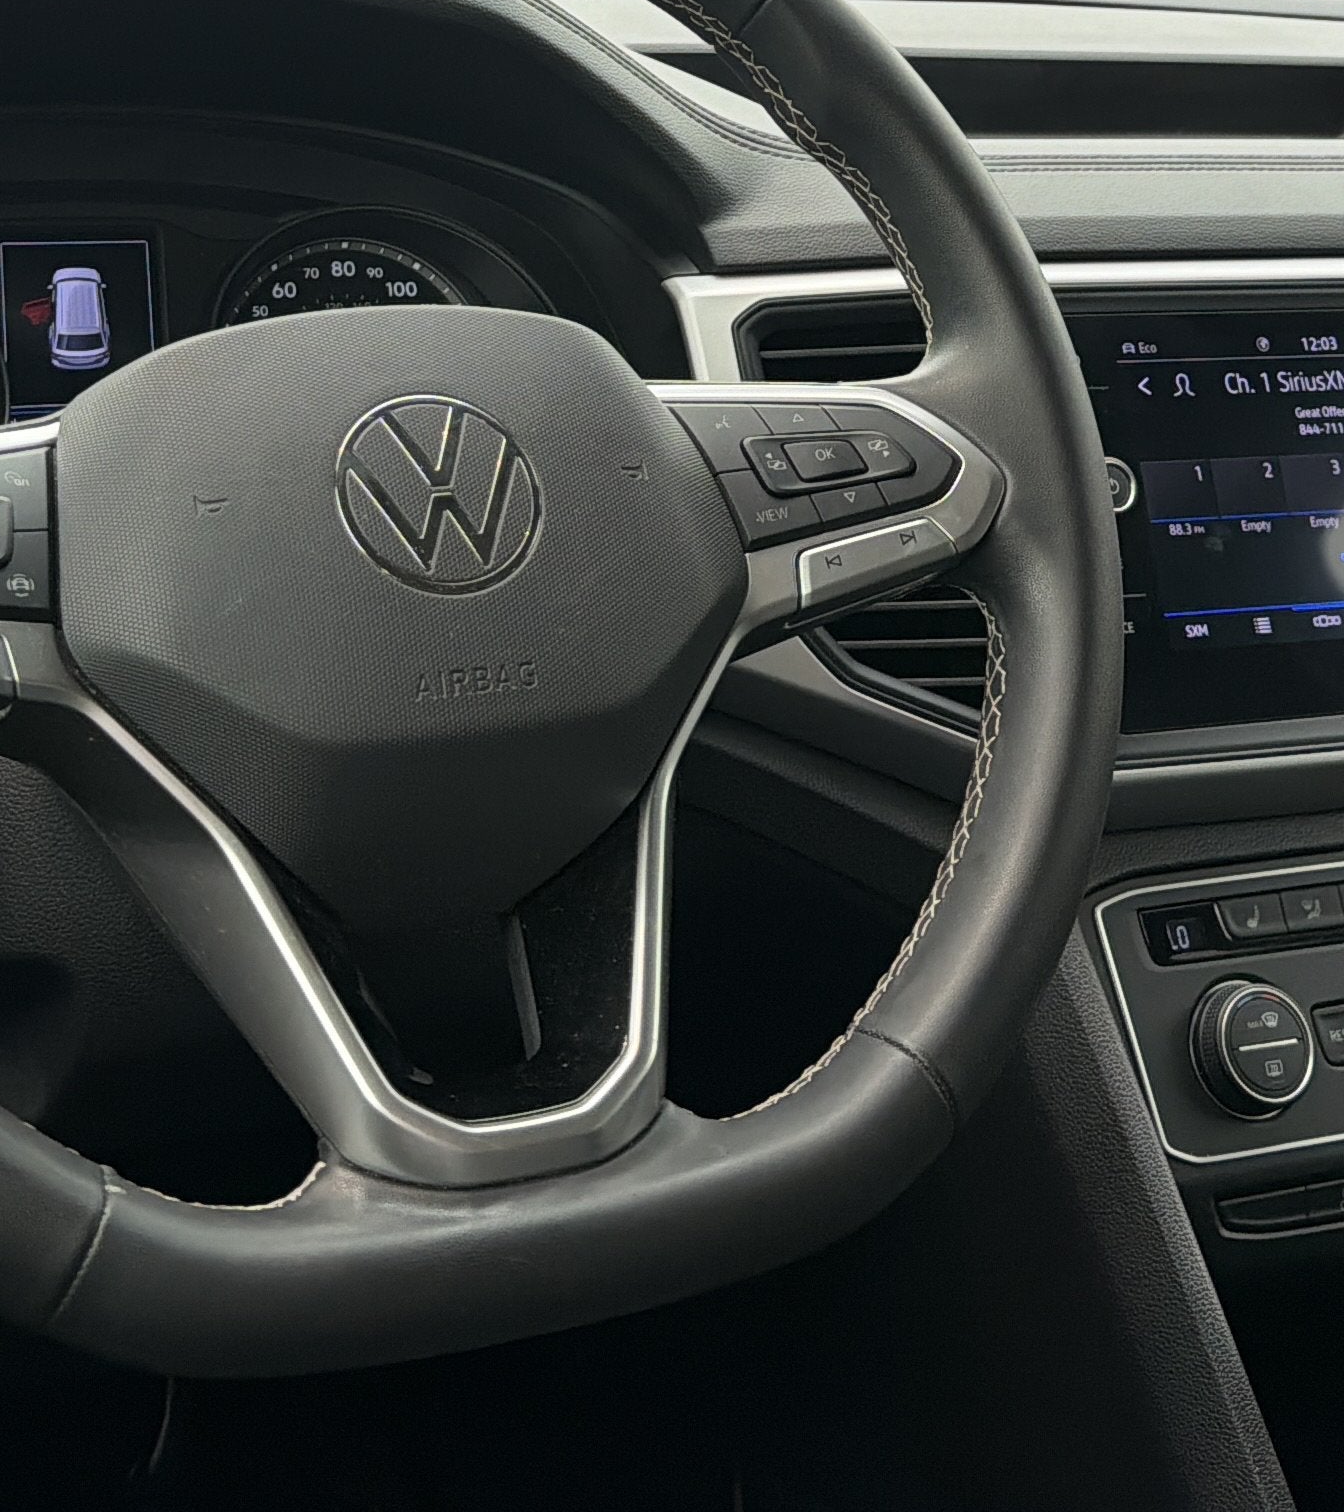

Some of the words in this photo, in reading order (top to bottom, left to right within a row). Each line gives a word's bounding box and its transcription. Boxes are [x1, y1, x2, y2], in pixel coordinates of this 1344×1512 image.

[302, 267, 320, 280] 70
[331, 261, 355, 277] 80
[366, 267, 383, 279] 90
[272, 282, 297, 299] 60
[386, 281, 417, 297] 100
[252, 305, 269, 318] 50
[1138, 342, 1157, 354] Eco
[1301, 337, 1338, 351] 12:03
[1224, 373, 1256, 394] Ch.
[1260, 372, 1270, 393] 1
[1294, 406, 1322, 418] Great
[815, 447, 836, 462] OK
[1193, 464, 1203, 482] 1
[1262, 462, 1274, 479] 2
[1329, 459, 1341, 475] 3
[756, 508, 788, 522] VIEW
[1309, 515, 1340, 529] Empty
[1169, 522, 1192, 536] 88.3
[1241, 519, 1272, 533] Empty
[1184, 623, 1209, 638] SXM
[415, 661, 539, 702] AIRBAG
